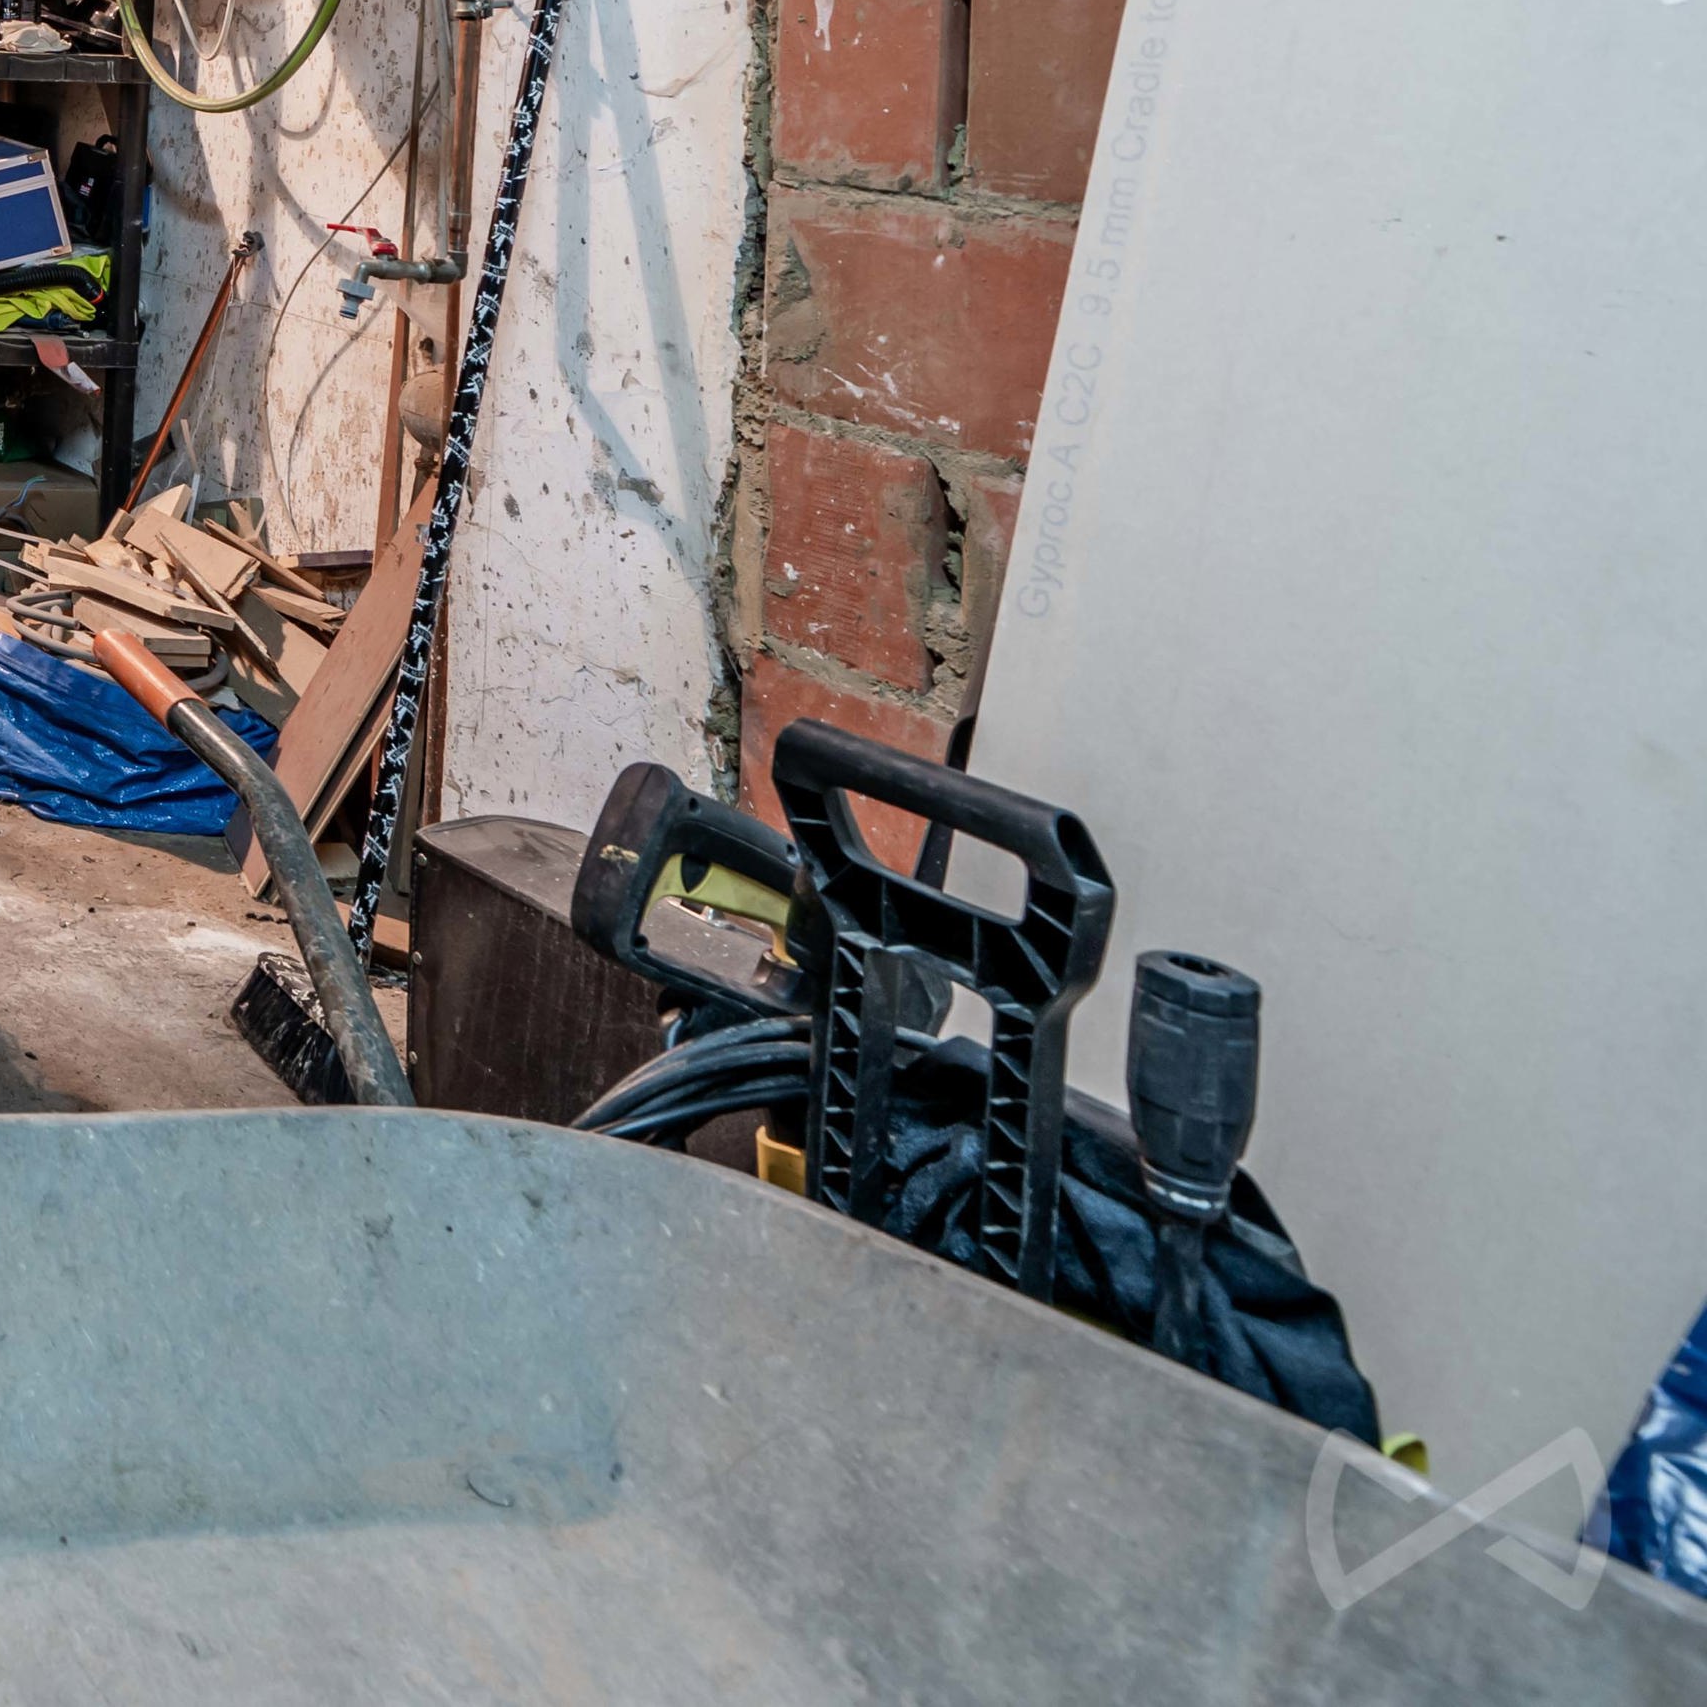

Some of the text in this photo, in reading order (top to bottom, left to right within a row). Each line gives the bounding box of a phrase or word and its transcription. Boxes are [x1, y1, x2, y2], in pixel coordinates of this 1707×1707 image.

[1111, 34, 1168, 158] Cradle
[1100, 175, 1135, 248] mm
[1079, 258, 1122, 317] 9.5
[1056, 341, 1102, 427] C2C
[1048, 441, 1081, 475] A
[1017, 480, 1074, 621] Gyproc
